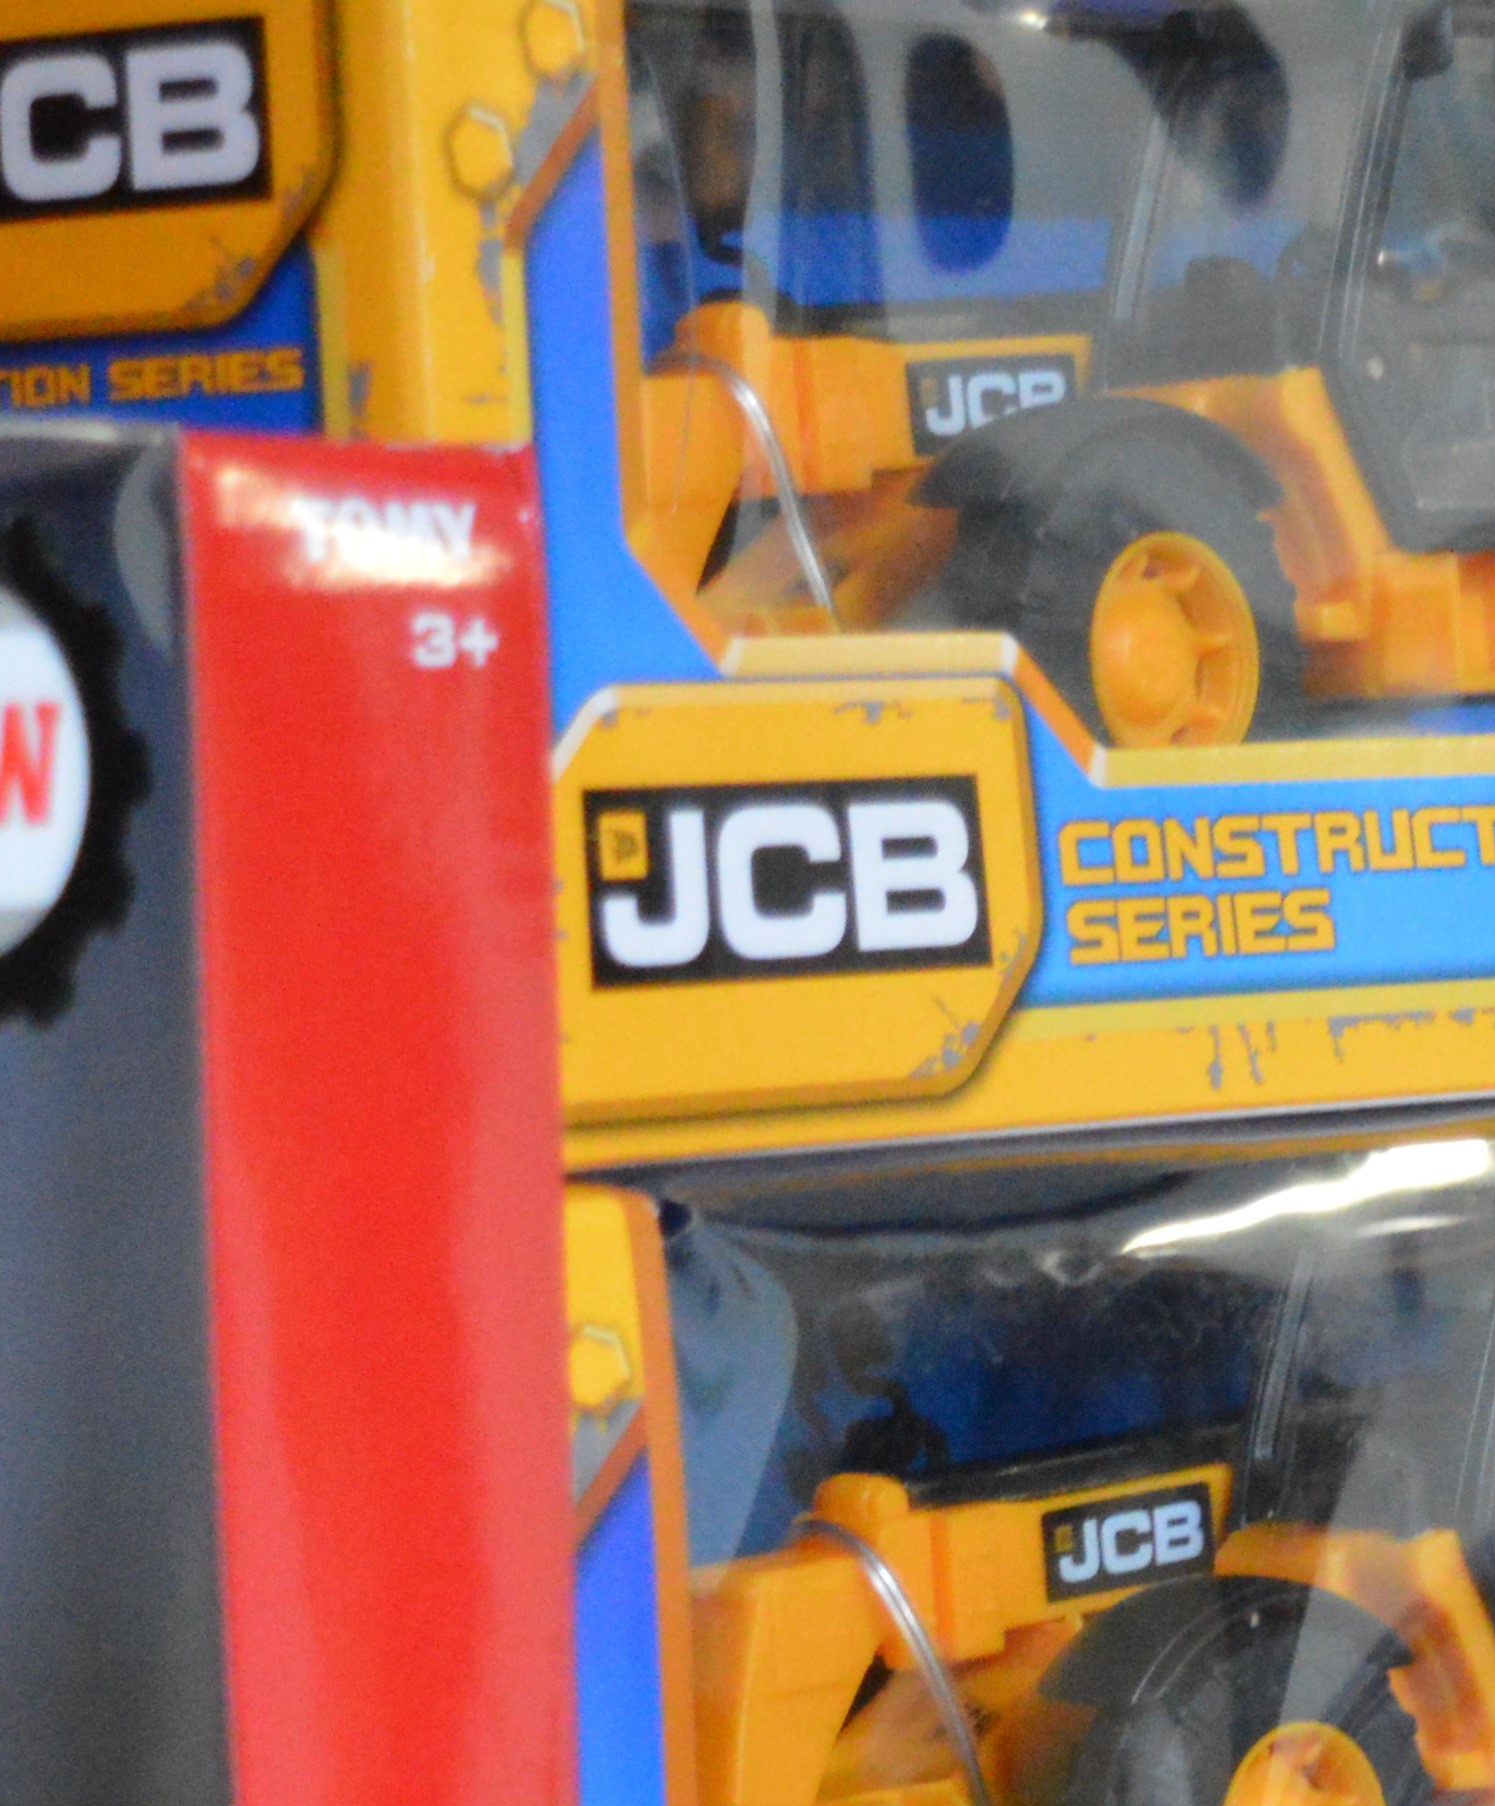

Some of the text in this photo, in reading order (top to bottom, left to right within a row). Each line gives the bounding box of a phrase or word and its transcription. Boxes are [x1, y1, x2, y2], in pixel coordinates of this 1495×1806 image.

[108, 346, 304, 401] SERIES
[296, 498, 478, 566] TOMY
[409, 612, 499, 670] 3+
[600, 800, 979, 970] JCB
[1066, 887, 1336, 966] SERIES
[1056, 1500, 1203, 1585] JCB
